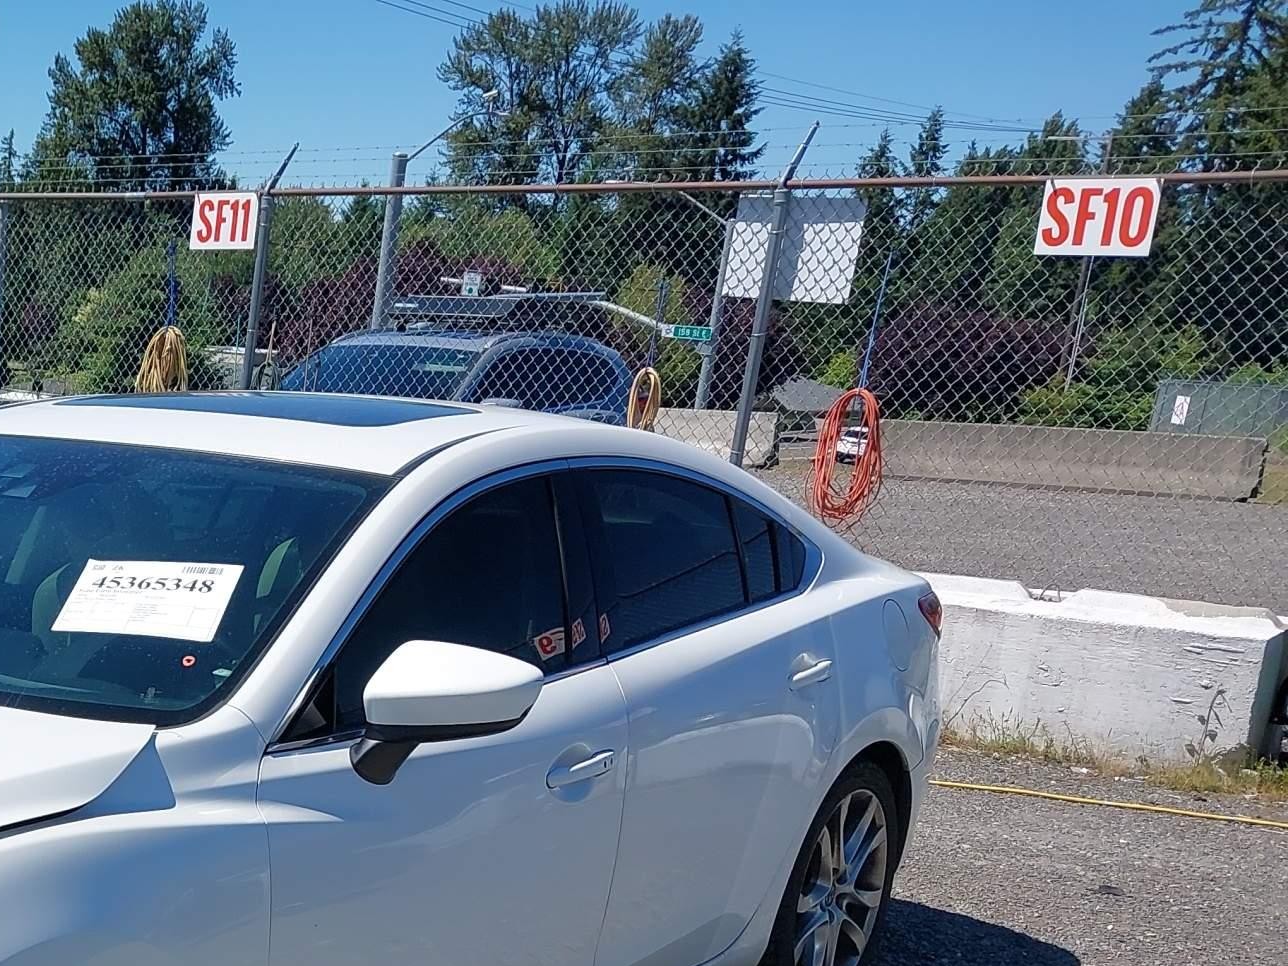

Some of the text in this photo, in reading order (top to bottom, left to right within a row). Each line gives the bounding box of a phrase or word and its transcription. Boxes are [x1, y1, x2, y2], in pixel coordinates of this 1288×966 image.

[196, 198, 252, 243] SF11
[1041, 186, 1155, 248] SF10
[91, 576, 215, 593] 45365348
